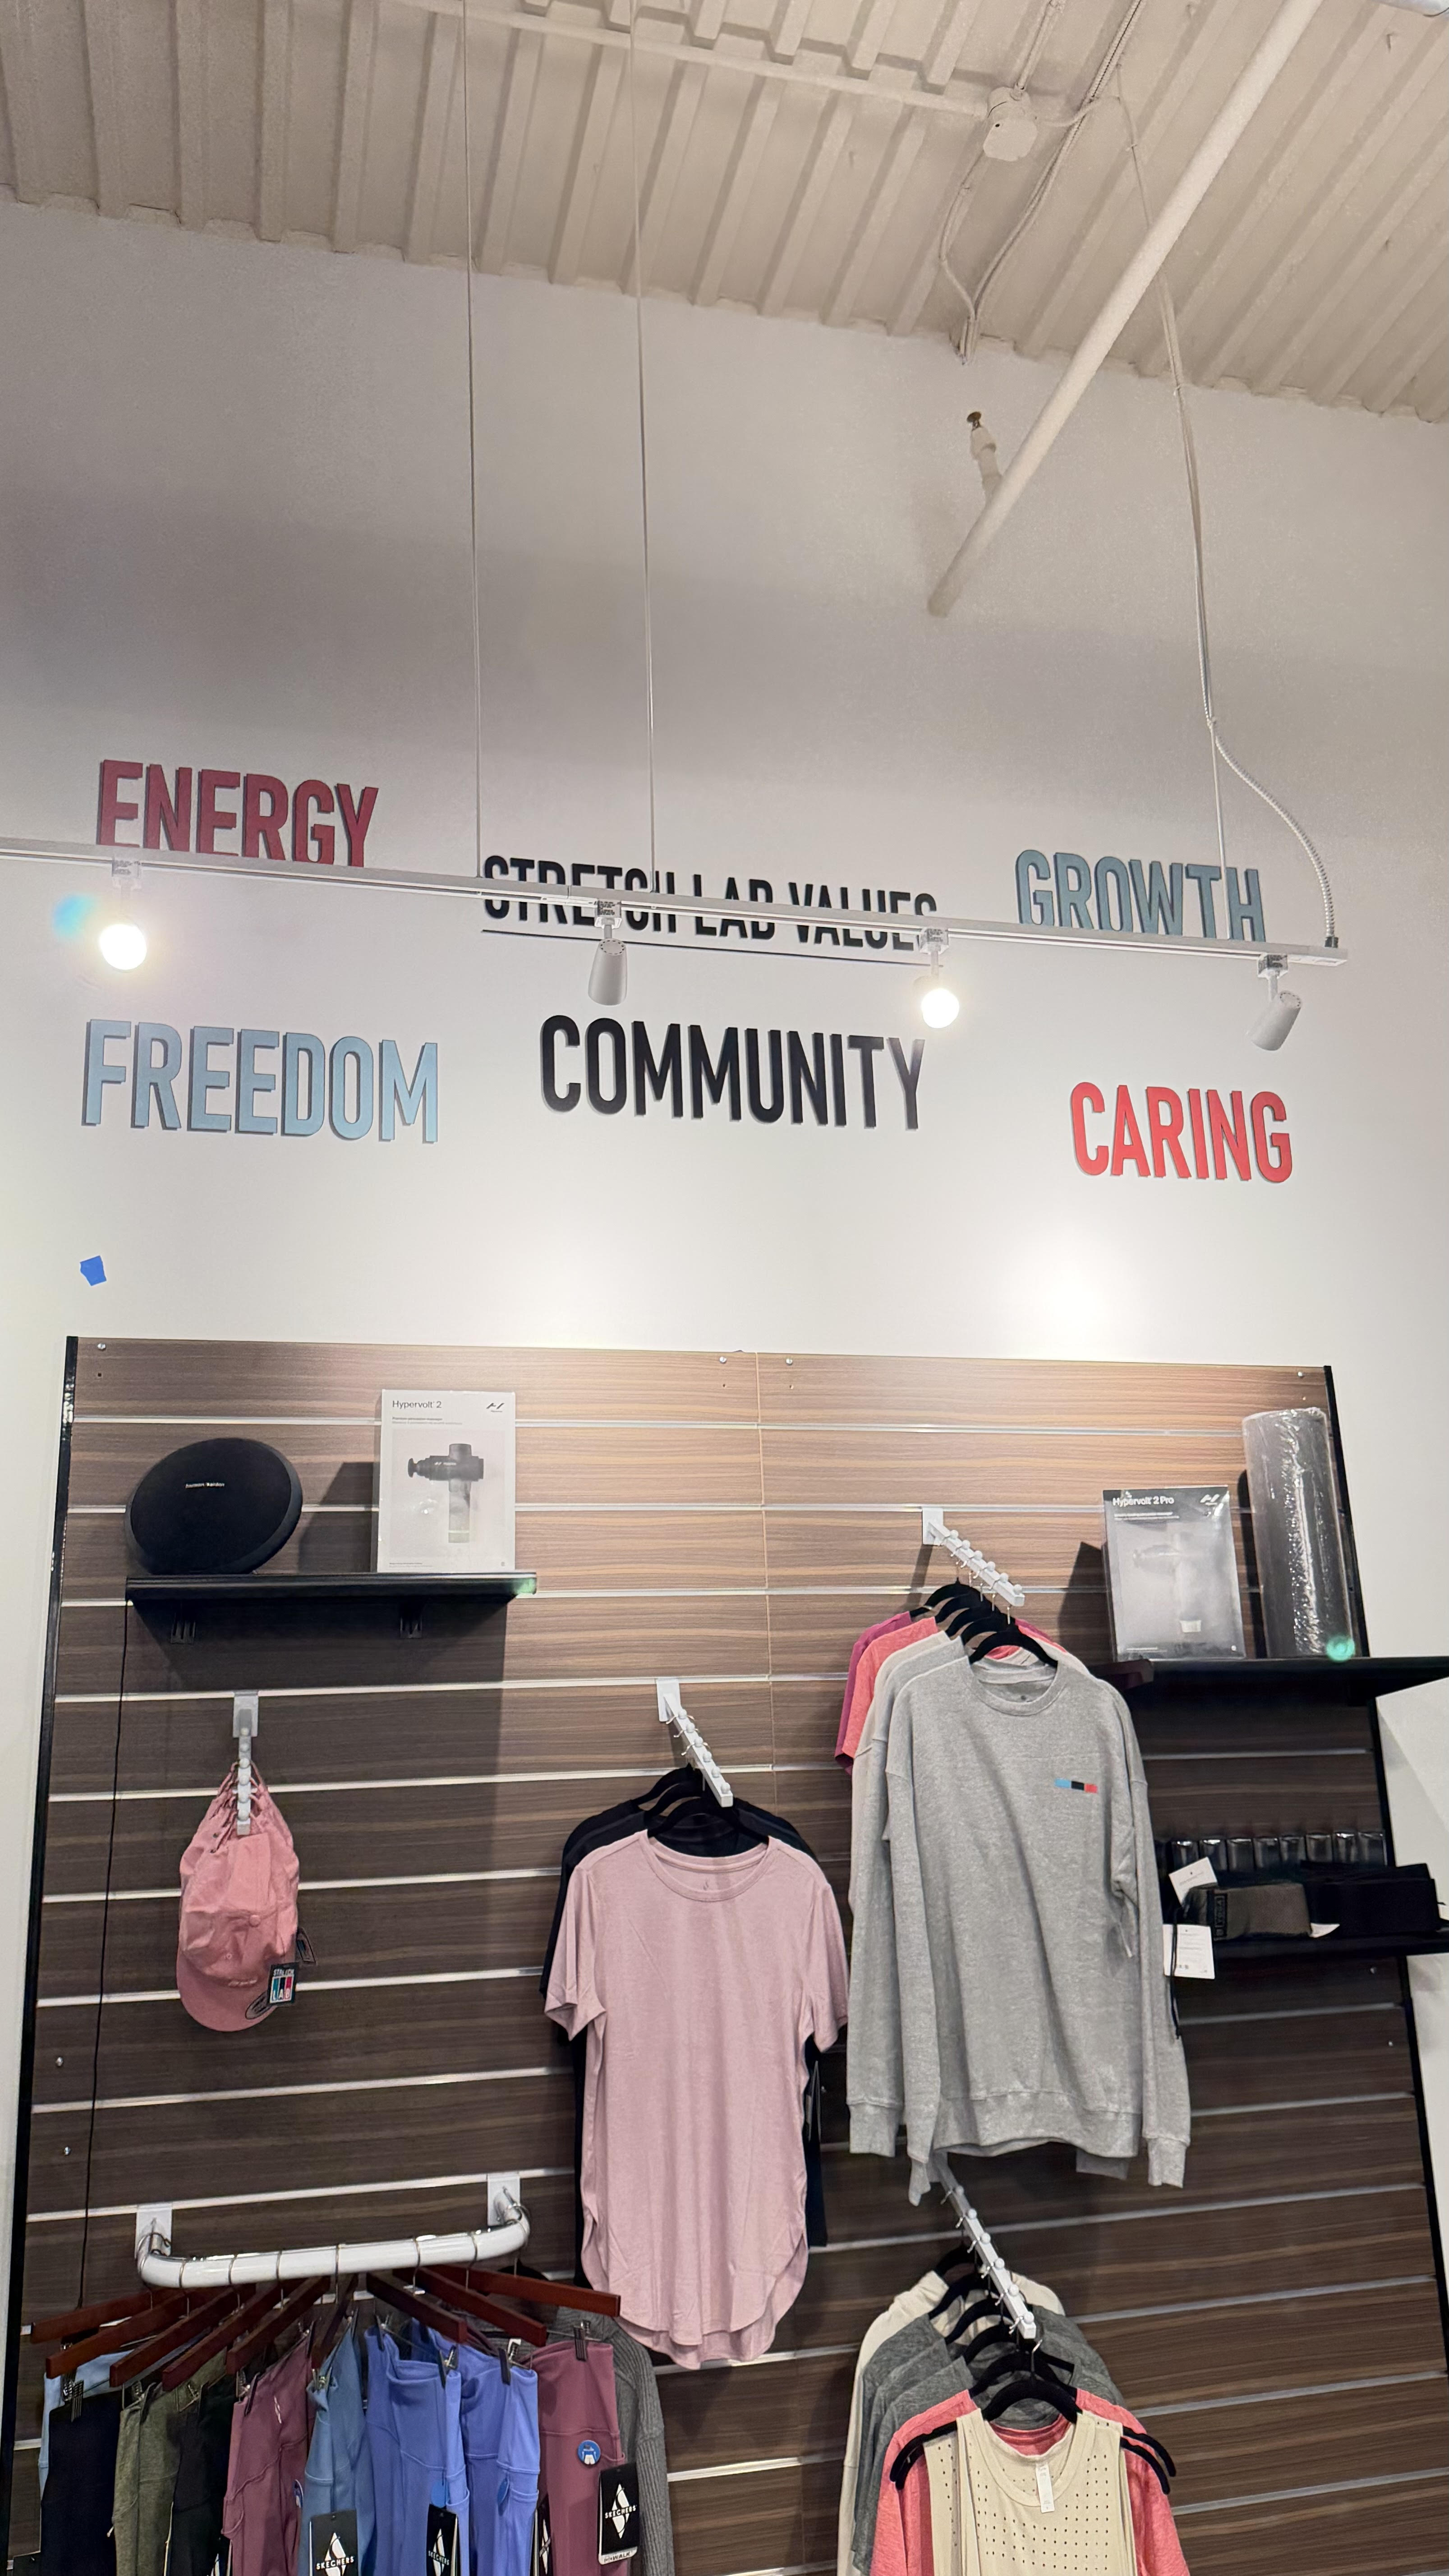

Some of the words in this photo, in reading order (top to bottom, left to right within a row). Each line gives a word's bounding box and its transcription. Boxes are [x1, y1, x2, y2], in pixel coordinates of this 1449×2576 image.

[96, 759, 379, 868] ENERGY
[694, 874, 776, 940] LAB
[1016, 850, 1266, 942] GROWTH
[81, 1019, 438, 1143] FREEDOM
[541, 1015, 925, 1130] COMMUNITY
[1070, 1082, 1293, 1183] CARING
[392, 1400, 433, 1409] Hypervolt
[1153, 1496, 1159, 1504] 2
[1160, 1496, 1174, 1504] Pro
[605, 2505, 636, 2519] SKECHERS
[316, 2556, 354, 2570] SKECHERS
